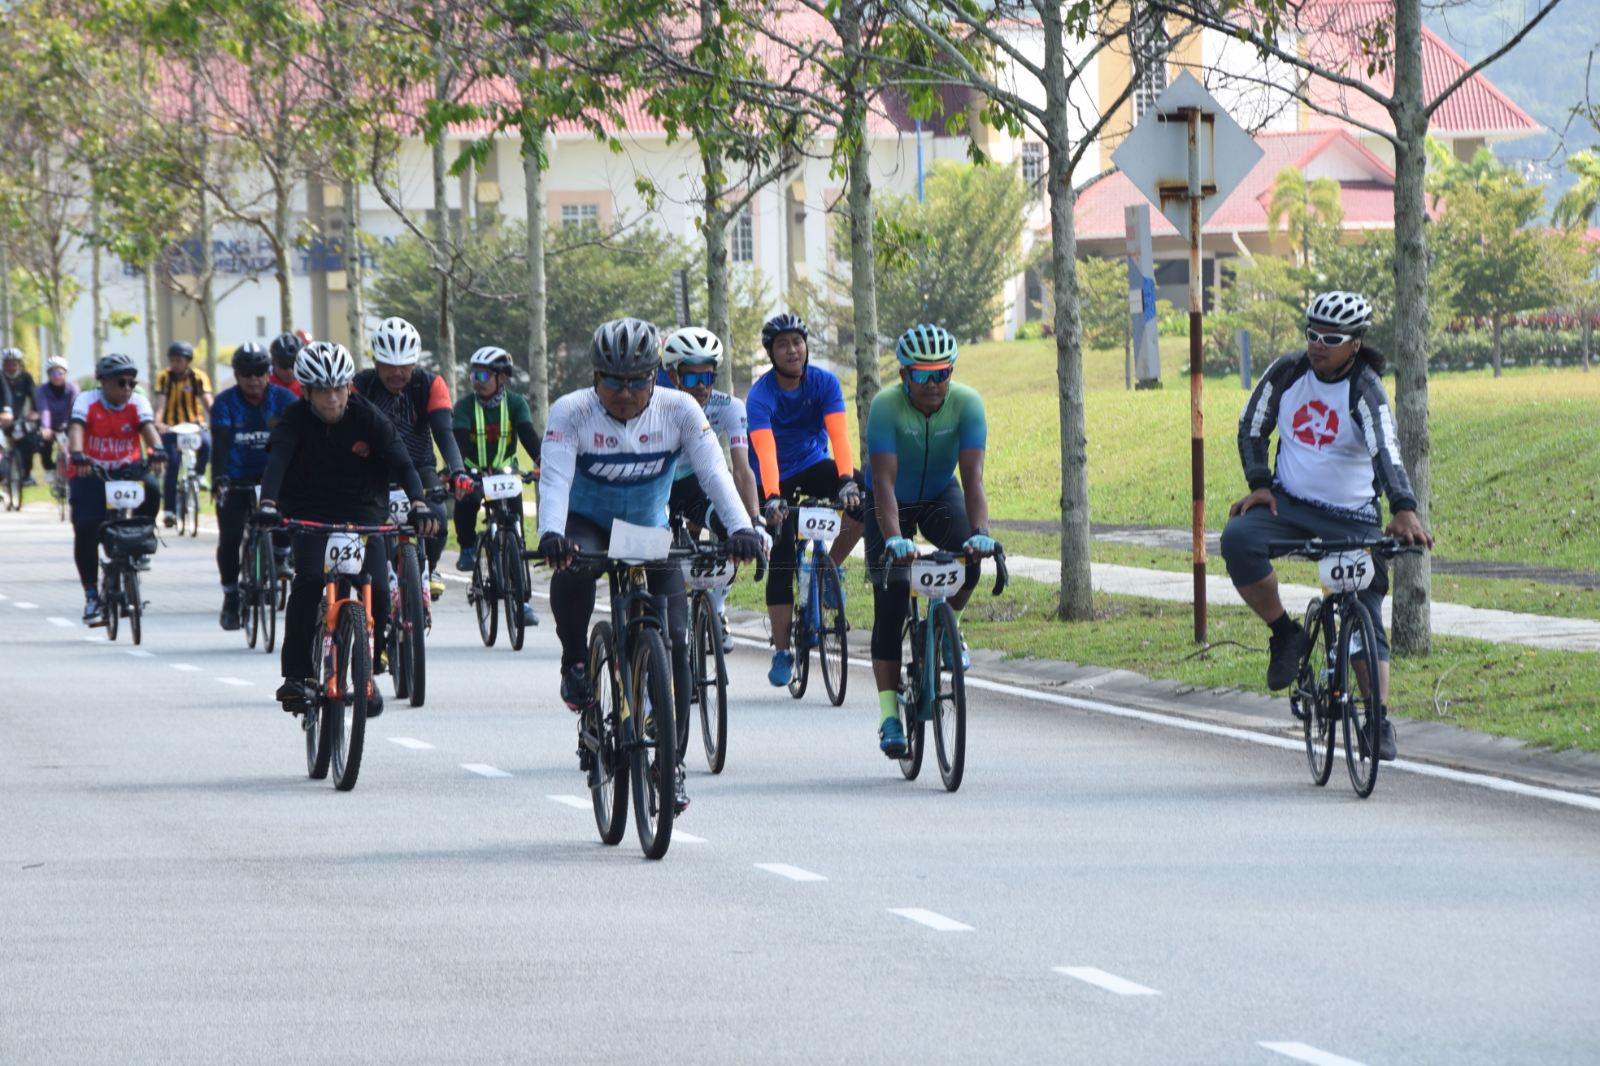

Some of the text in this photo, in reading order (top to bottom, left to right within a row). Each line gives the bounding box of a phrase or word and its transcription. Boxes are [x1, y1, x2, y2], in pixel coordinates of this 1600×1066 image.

[492, 482, 515, 492] 132
[114, 490, 138, 501] 041
[389, 501, 411, 514] 03
[805, 517, 836, 532] 052
[329, 546, 362, 561] 034
[1330, 561, 1367, 580] 015
[919, 570, 959, 587] 023
